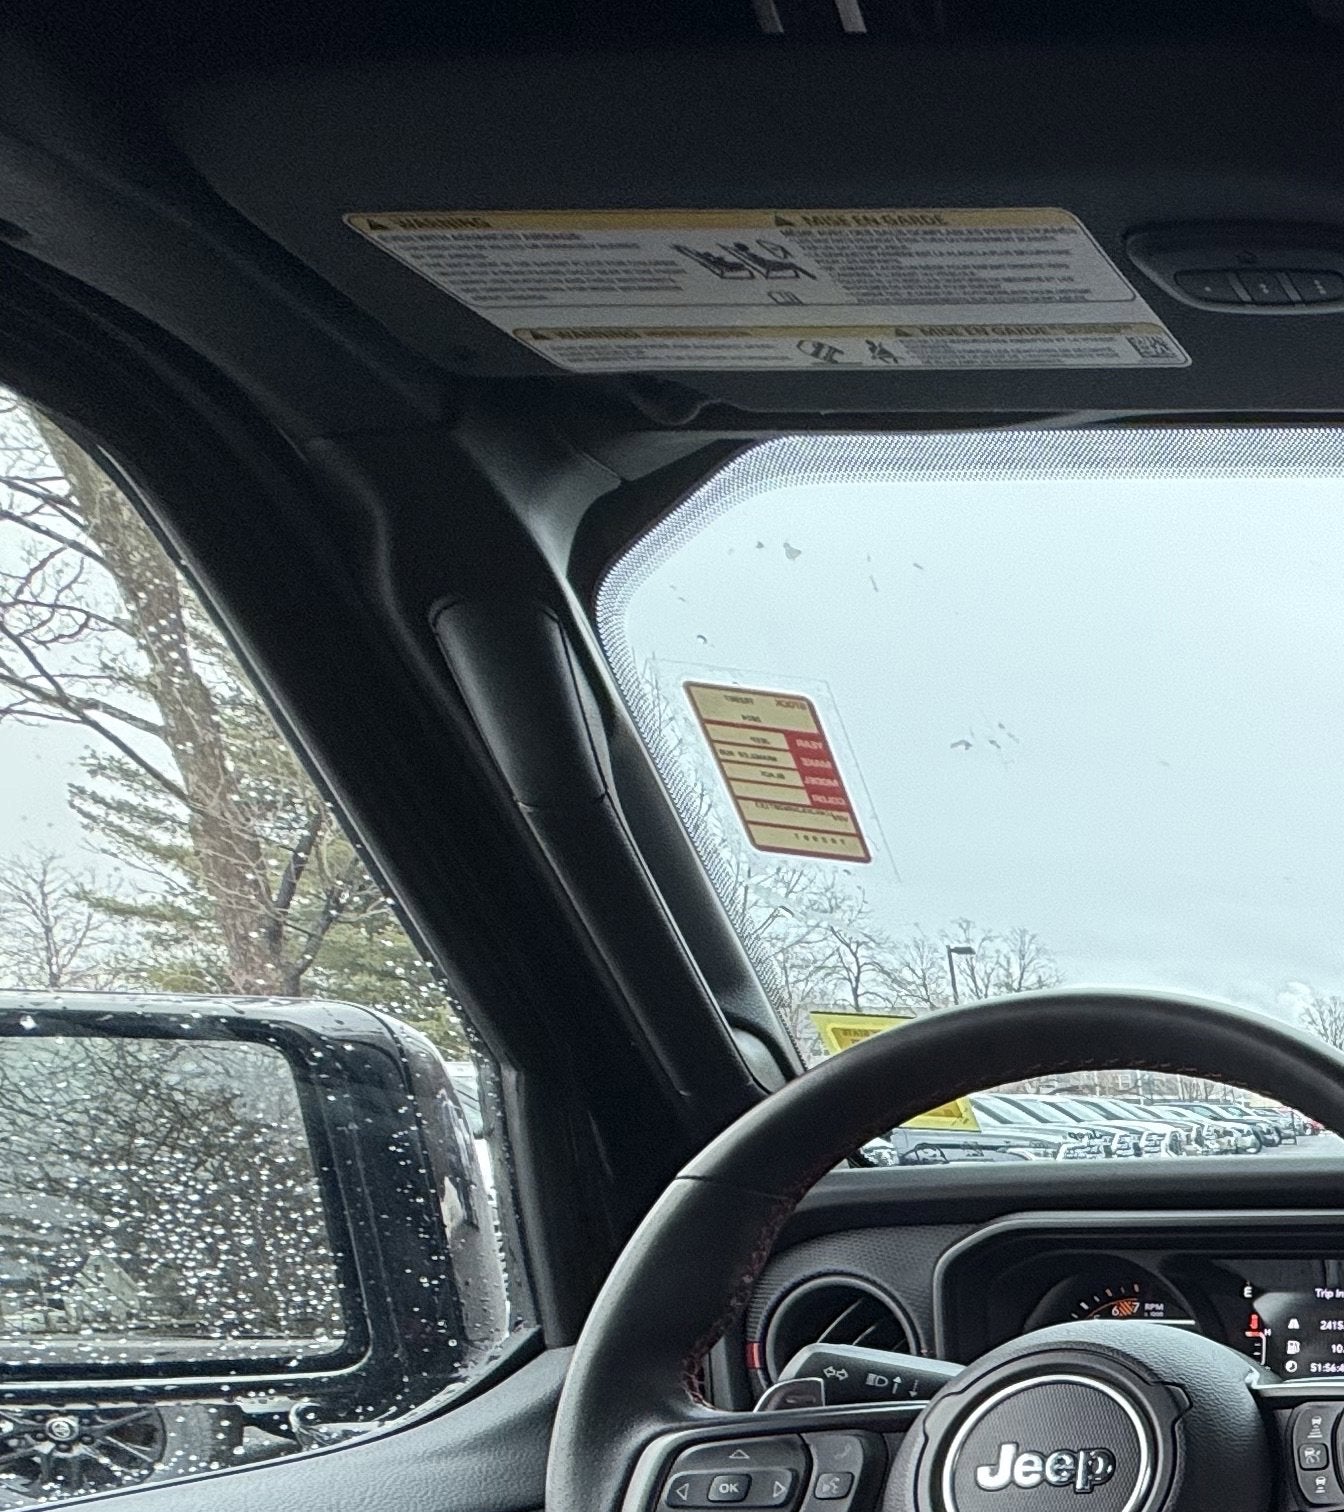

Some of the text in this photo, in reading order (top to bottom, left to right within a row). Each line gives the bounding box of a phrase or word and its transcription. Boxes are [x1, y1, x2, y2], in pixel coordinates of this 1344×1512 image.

[1314, 1288, 1334, 1300] Trip
[1111, 1305, 1119, 1316] 6
[1131, 1302, 1140, 1313] 7
[1144, 1303, 1164, 1311] RPM
[975, 1440, 1116, 1495] Jeep
[718, 1482, 740, 1495] OK
